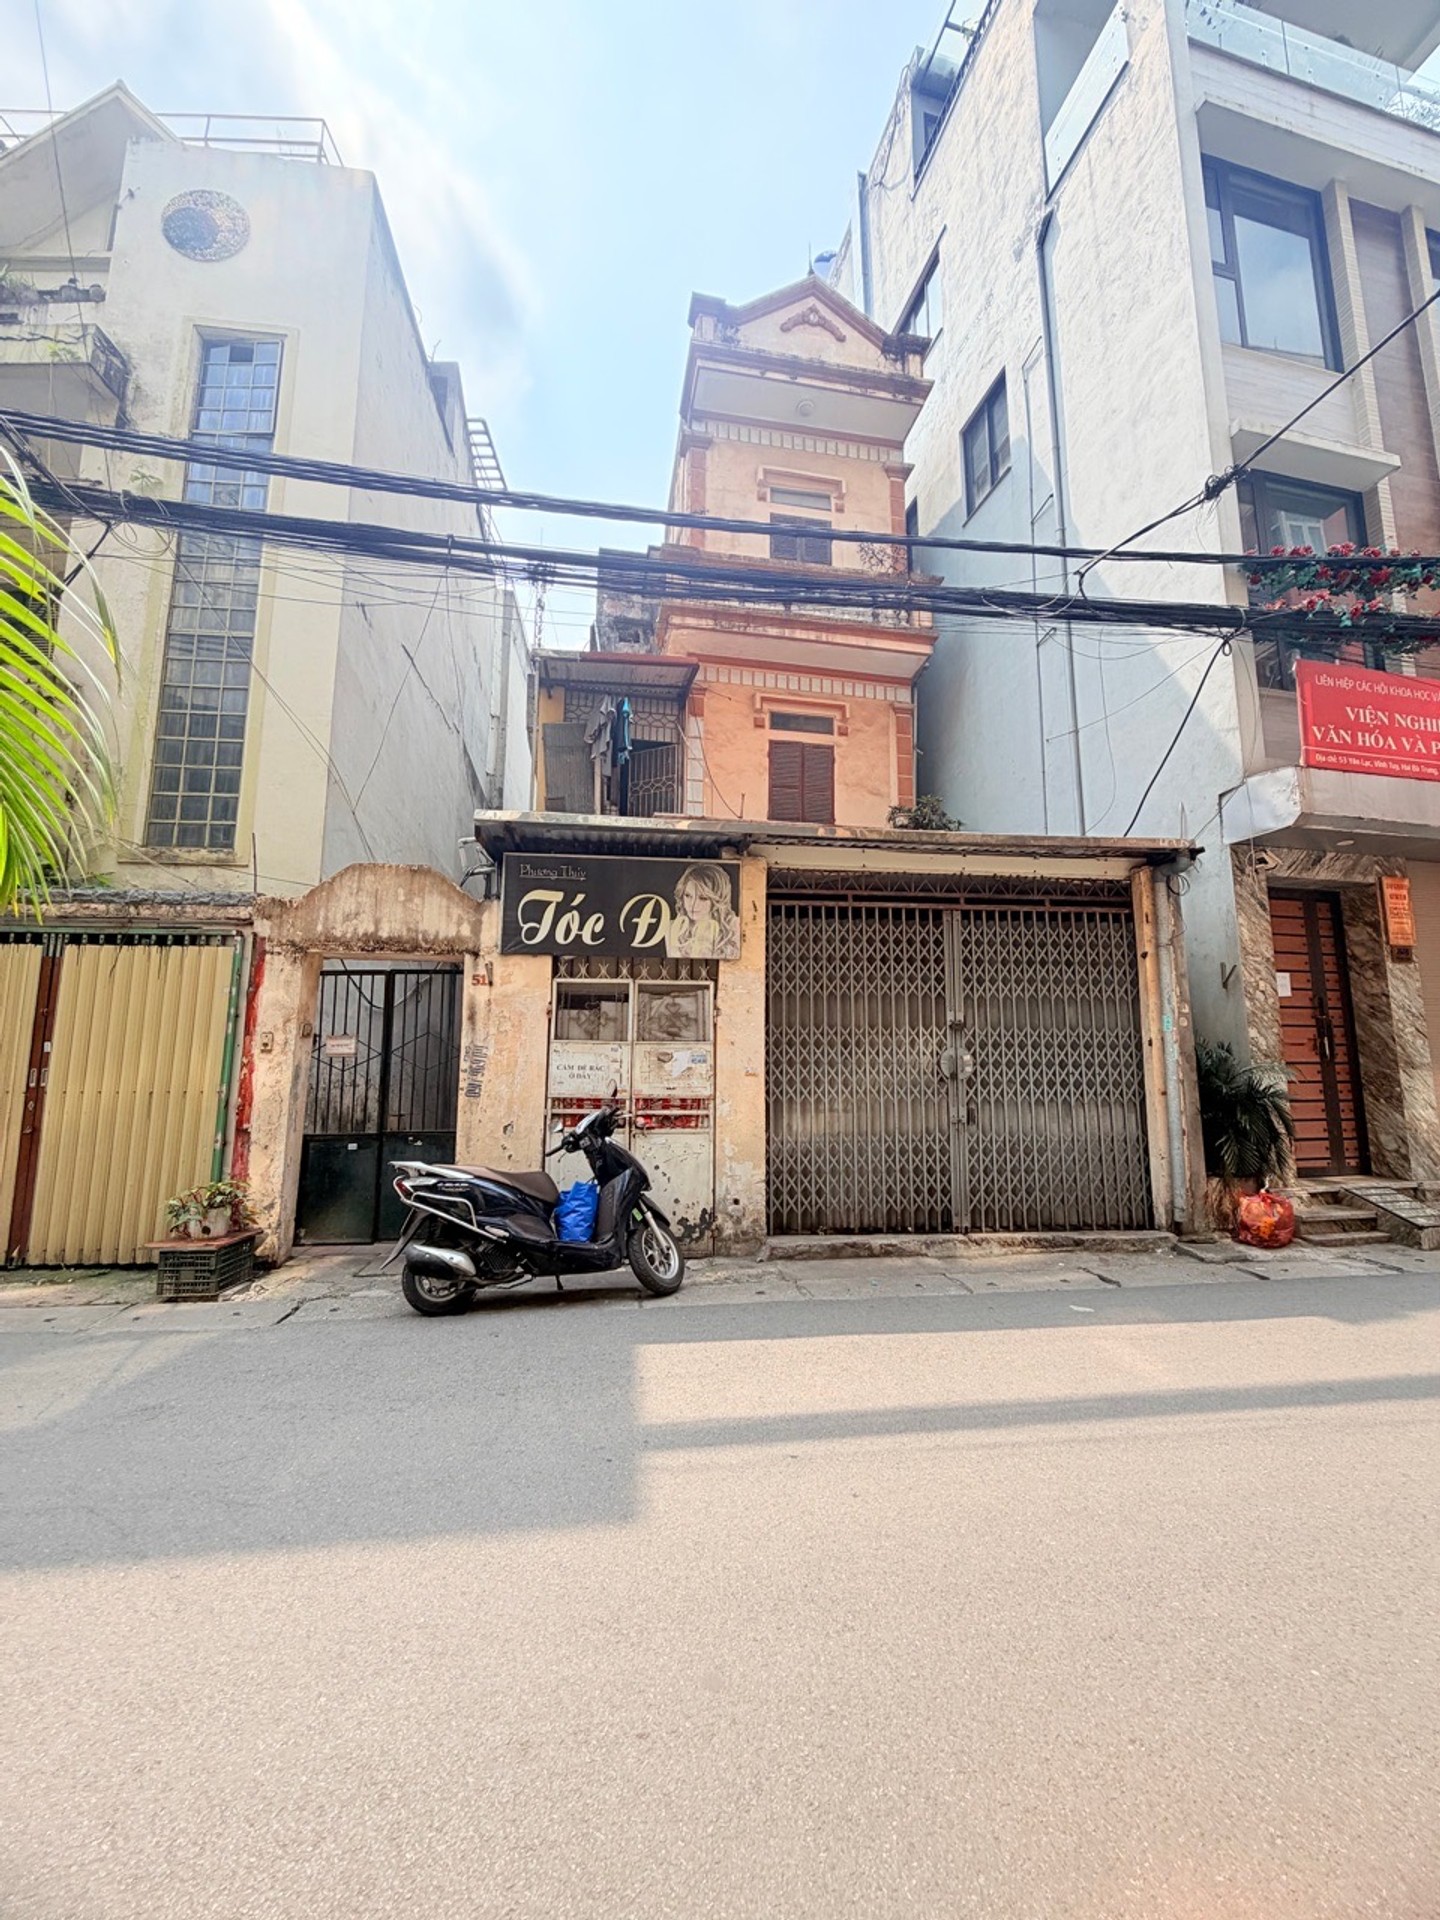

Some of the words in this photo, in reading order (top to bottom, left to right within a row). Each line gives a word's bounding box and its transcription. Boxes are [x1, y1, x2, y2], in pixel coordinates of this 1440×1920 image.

[1315, 674, 1334, 687] LIÊN
[1335, 676, 1354, 690] HIỆP
[1356, 680, 1372, 692] CÁC
[1374, 682, 1389, 694] HỘI
[1390, 686, 1412, 698] KHOA
[1413, 690, 1430, 701] HỌC
[1345, 705, 1389, 728] VIỆN
[1312, 724, 1352, 744] VĂN
[1357, 729, 1397, 750] HÓA
[1401, 734, 1427, 754] VÀ
[1338, 755, 1347, 765] 53
[517, 889, 606, 945] Tóc
